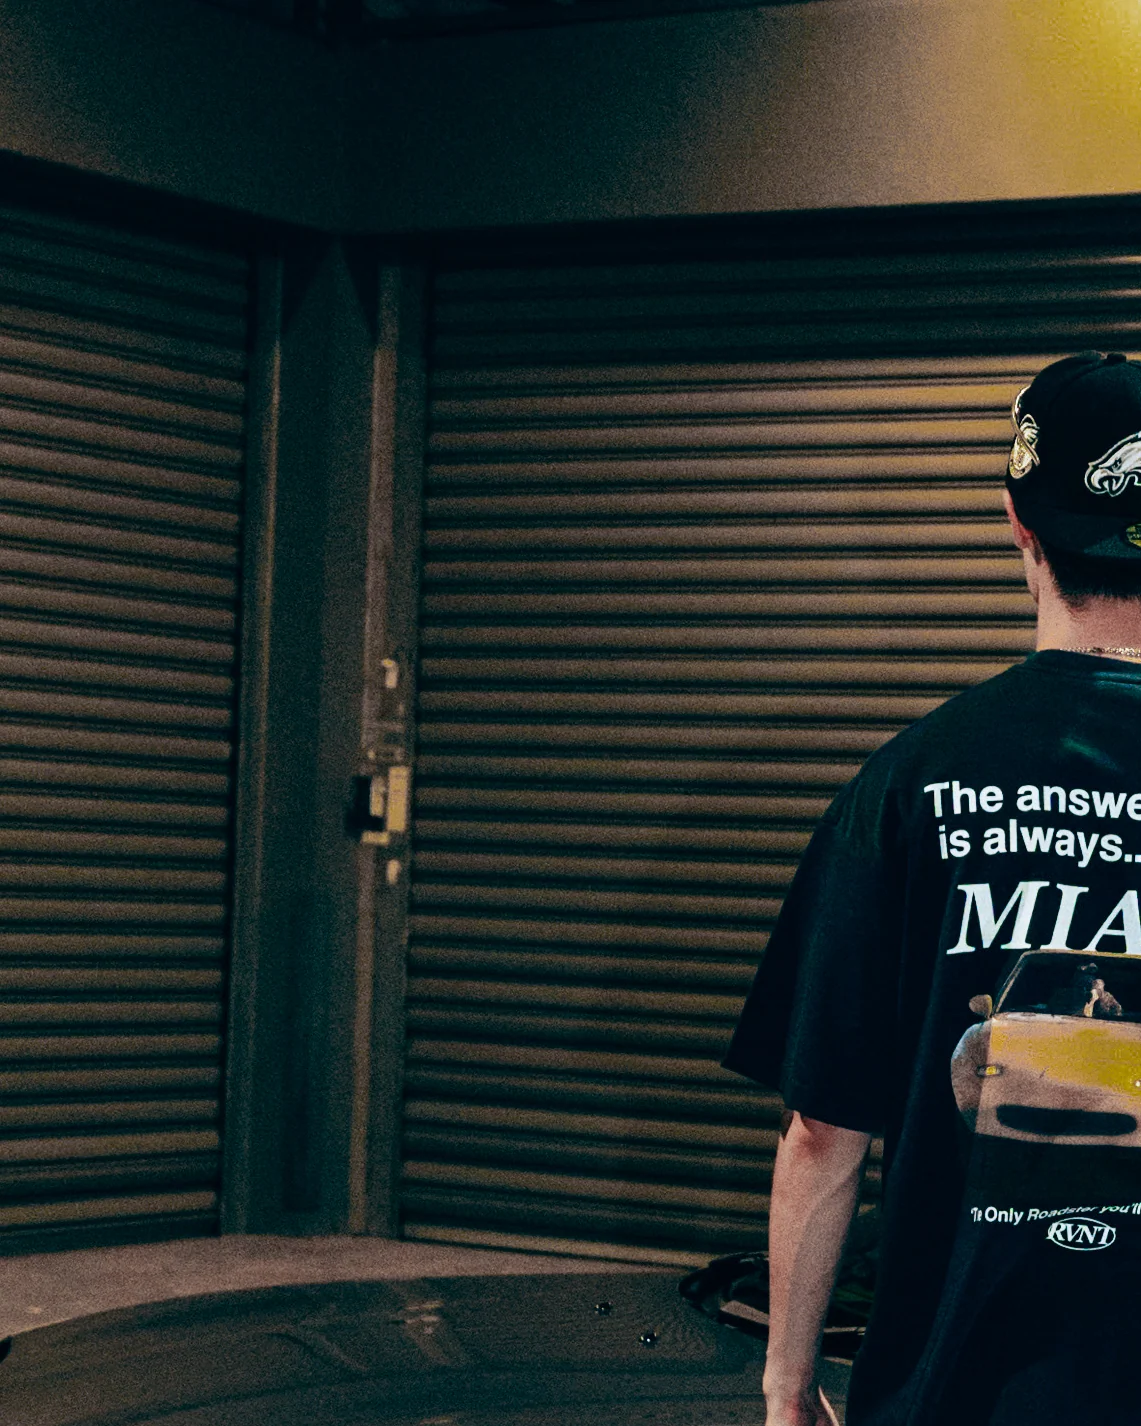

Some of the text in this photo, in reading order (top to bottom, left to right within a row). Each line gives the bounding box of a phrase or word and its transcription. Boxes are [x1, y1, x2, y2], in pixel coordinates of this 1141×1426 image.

[923, 780, 1004, 818] The
[938, 824, 971, 860] is
[984, 1206, 1024, 1225] Only
[1027, 1204, 1099, 1221] Roadster
[1046, 1222, 1117, 1245] RVNT
